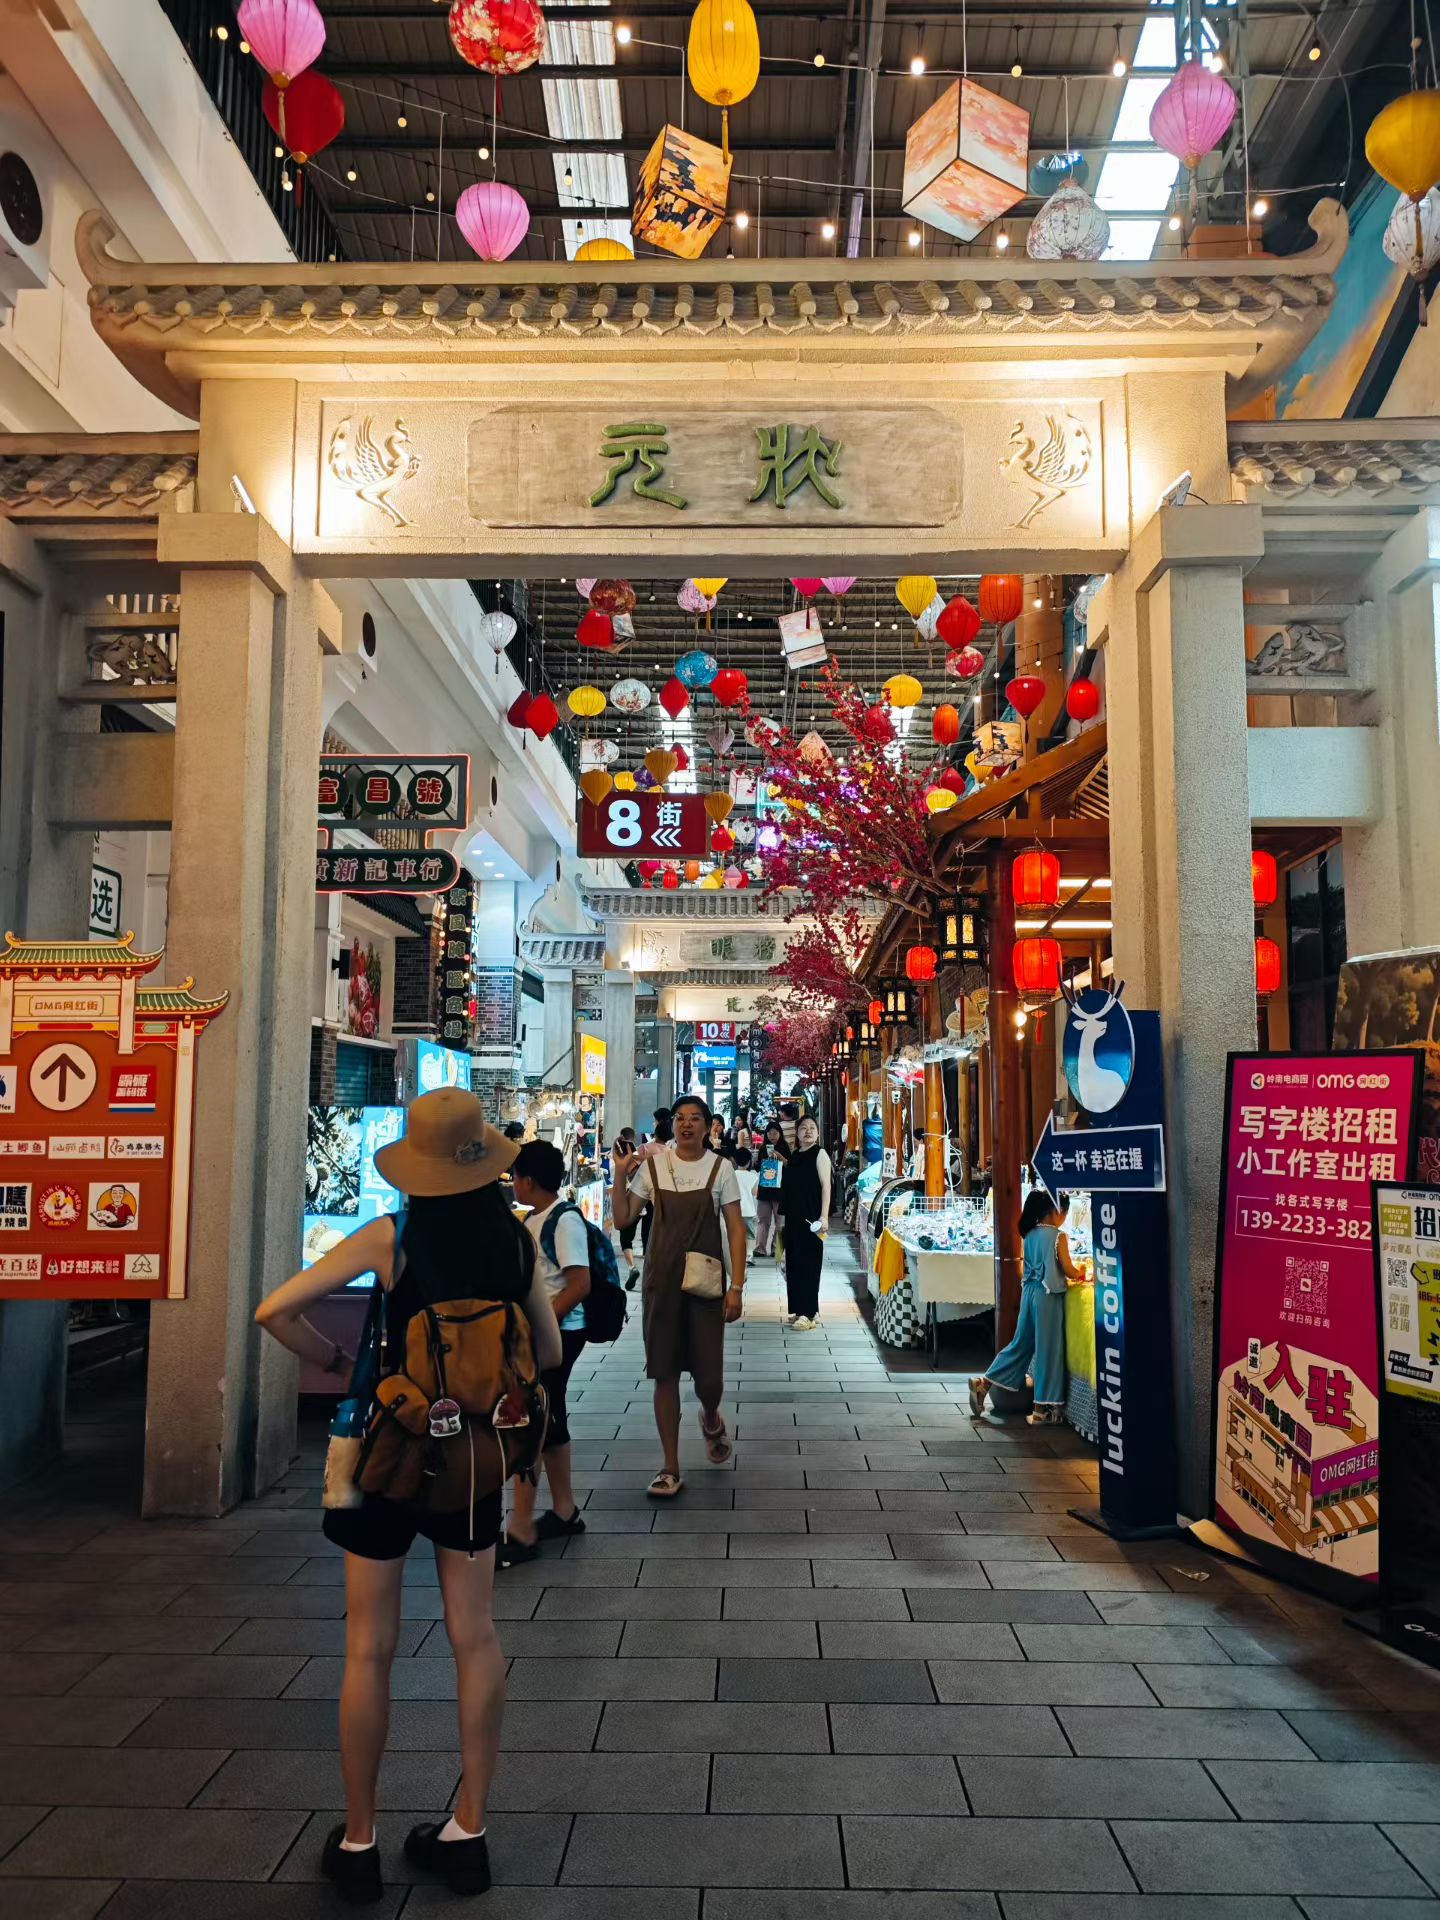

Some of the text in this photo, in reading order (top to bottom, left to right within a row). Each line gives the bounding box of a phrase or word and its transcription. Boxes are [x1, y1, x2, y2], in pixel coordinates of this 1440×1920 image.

[606, 799, 682, 847] 8 街
[701, 1022, 719, 1039] 10
[1239, 1105, 1398, 1145] 写字楼招租
[1051, 1147, 1144, 1172] 这一杯 幸运在握
[1237, 1146, 1397, 1182] 小工作室出租
[1275, 1193, 1349, 1212] 找各式写字楼
[60, 1260, 105, 1274] 好想来
[1279, 1310, 1331, 1329] 欢迎扫码咨询
[1096, 1203, 1124, 1476] luckin coffee
[1263, 1341, 1353, 1431] 入驻
